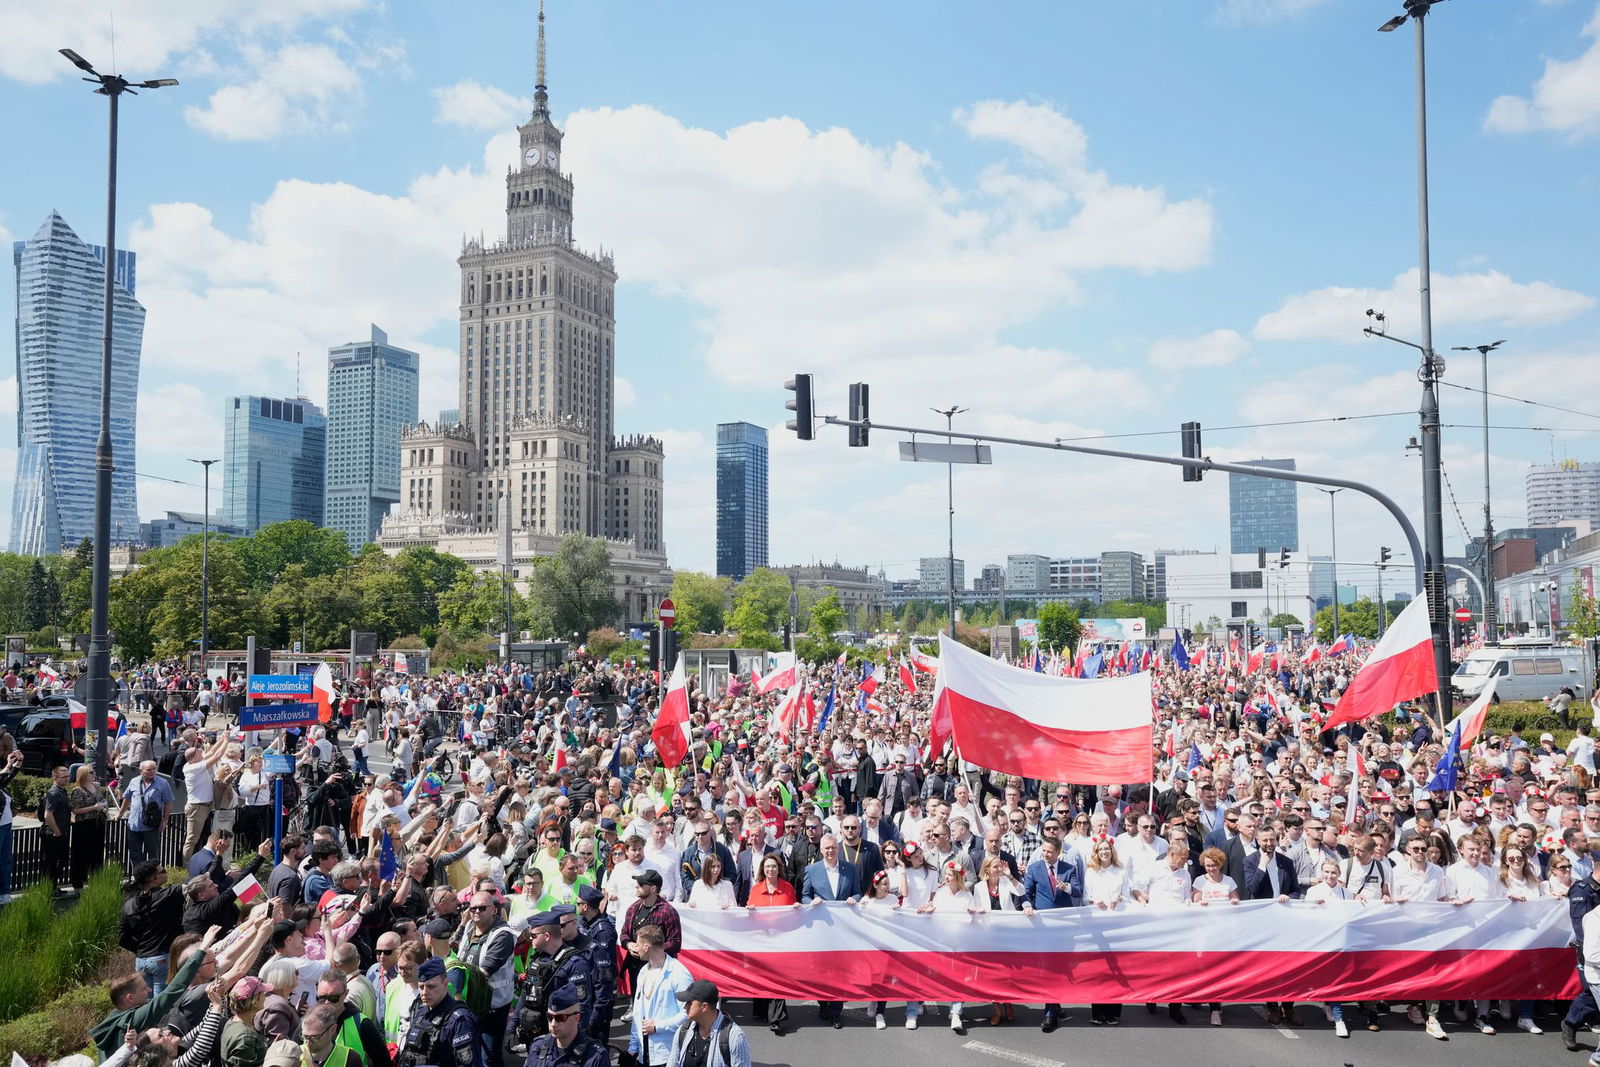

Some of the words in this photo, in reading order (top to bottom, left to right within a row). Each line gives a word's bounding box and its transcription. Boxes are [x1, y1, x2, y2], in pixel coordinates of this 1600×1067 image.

[251, 681, 265, 692] Aleje
[267, 681, 309, 691] Jerozolimskie
[253, 709, 310, 722] Marszałkowska
[453, 1034, 470, 1044] POLICJA
